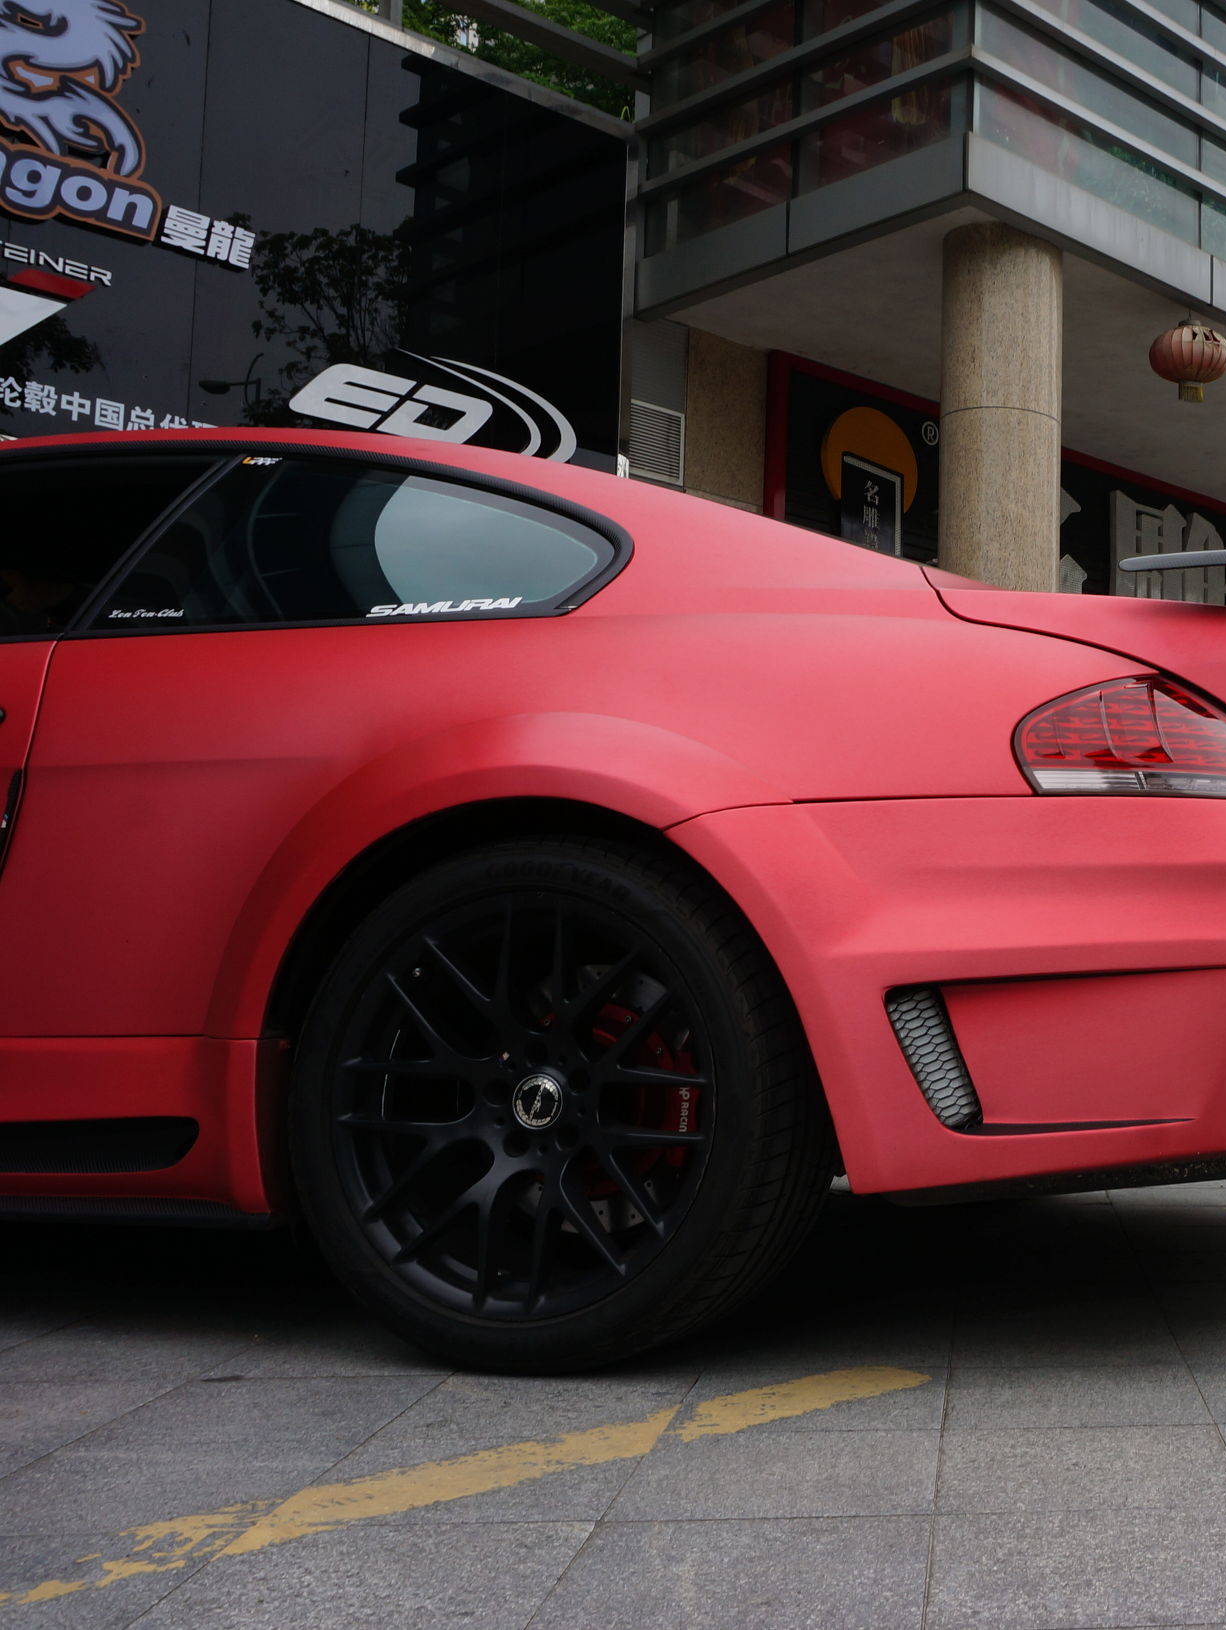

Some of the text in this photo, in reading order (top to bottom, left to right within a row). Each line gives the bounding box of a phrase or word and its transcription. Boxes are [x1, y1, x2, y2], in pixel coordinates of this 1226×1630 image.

[0, 151, 154, 229] gon
[0, 241, 112, 287] EINER
[161, 204, 256, 269] 曼龍
[289, 363, 493, 446] ED
[366, 597, 523, 618] SAMURAI
